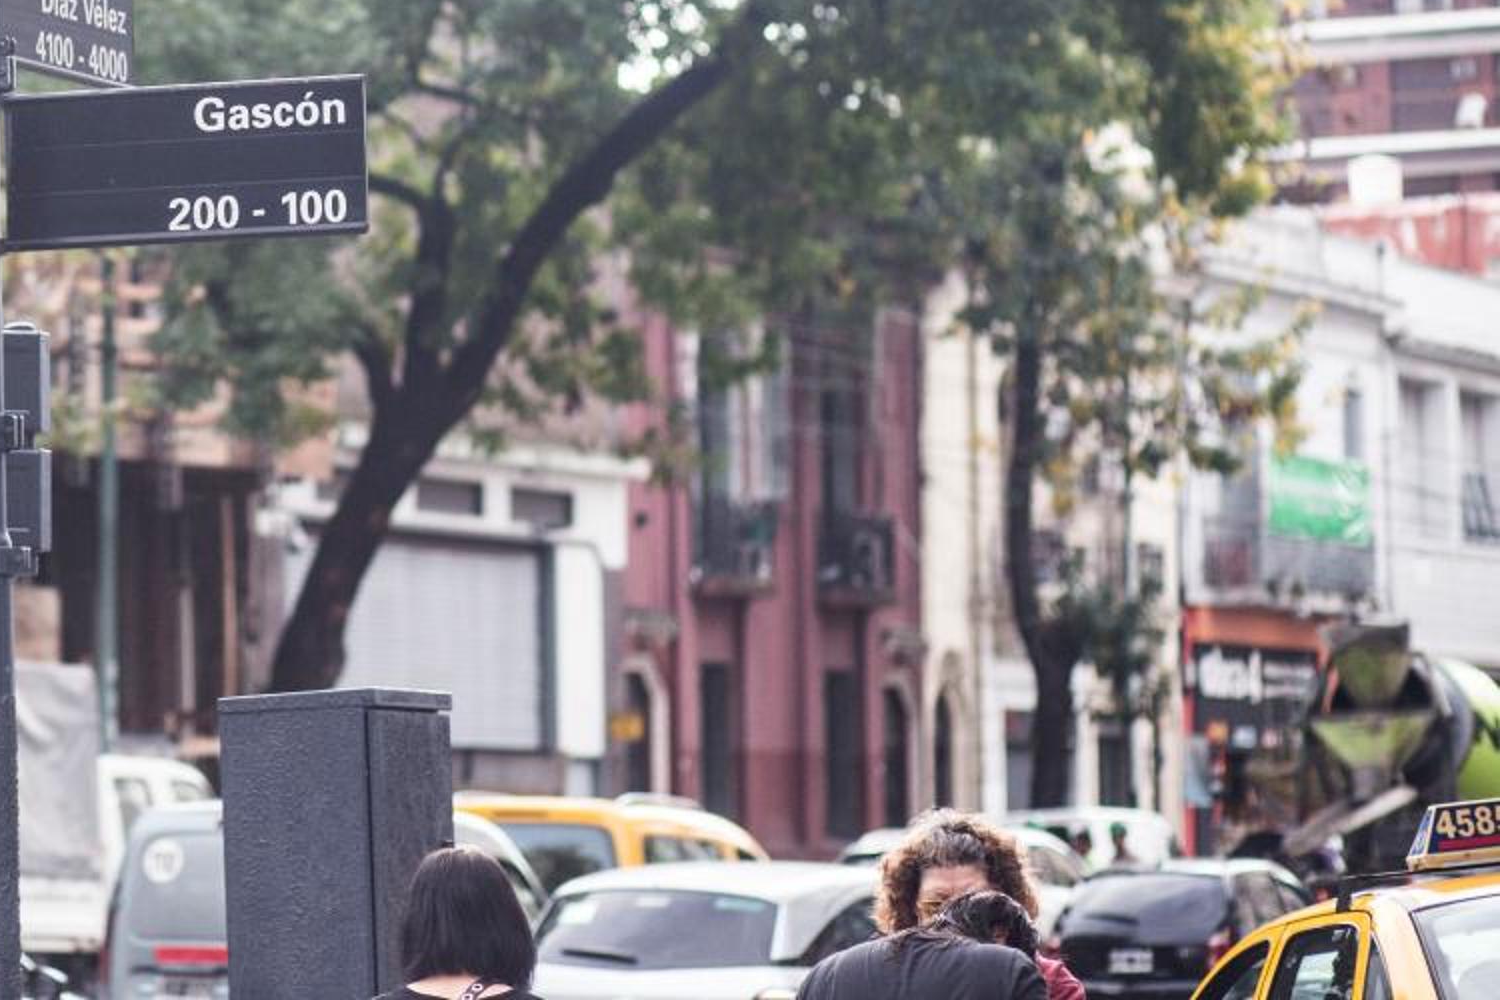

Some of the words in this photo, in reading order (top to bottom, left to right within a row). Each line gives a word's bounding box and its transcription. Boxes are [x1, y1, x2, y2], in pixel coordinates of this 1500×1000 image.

[35, 31, 74, 69] 4100
[88, 44, 128, 83] 4000
[193, 91, 346, 132] Gascón
[167, 195, 240, 231] 200
[252, 208, 266, 217] -
[281, 189, 347, 225] 100
[1436, 805, 1500, 839] 458
